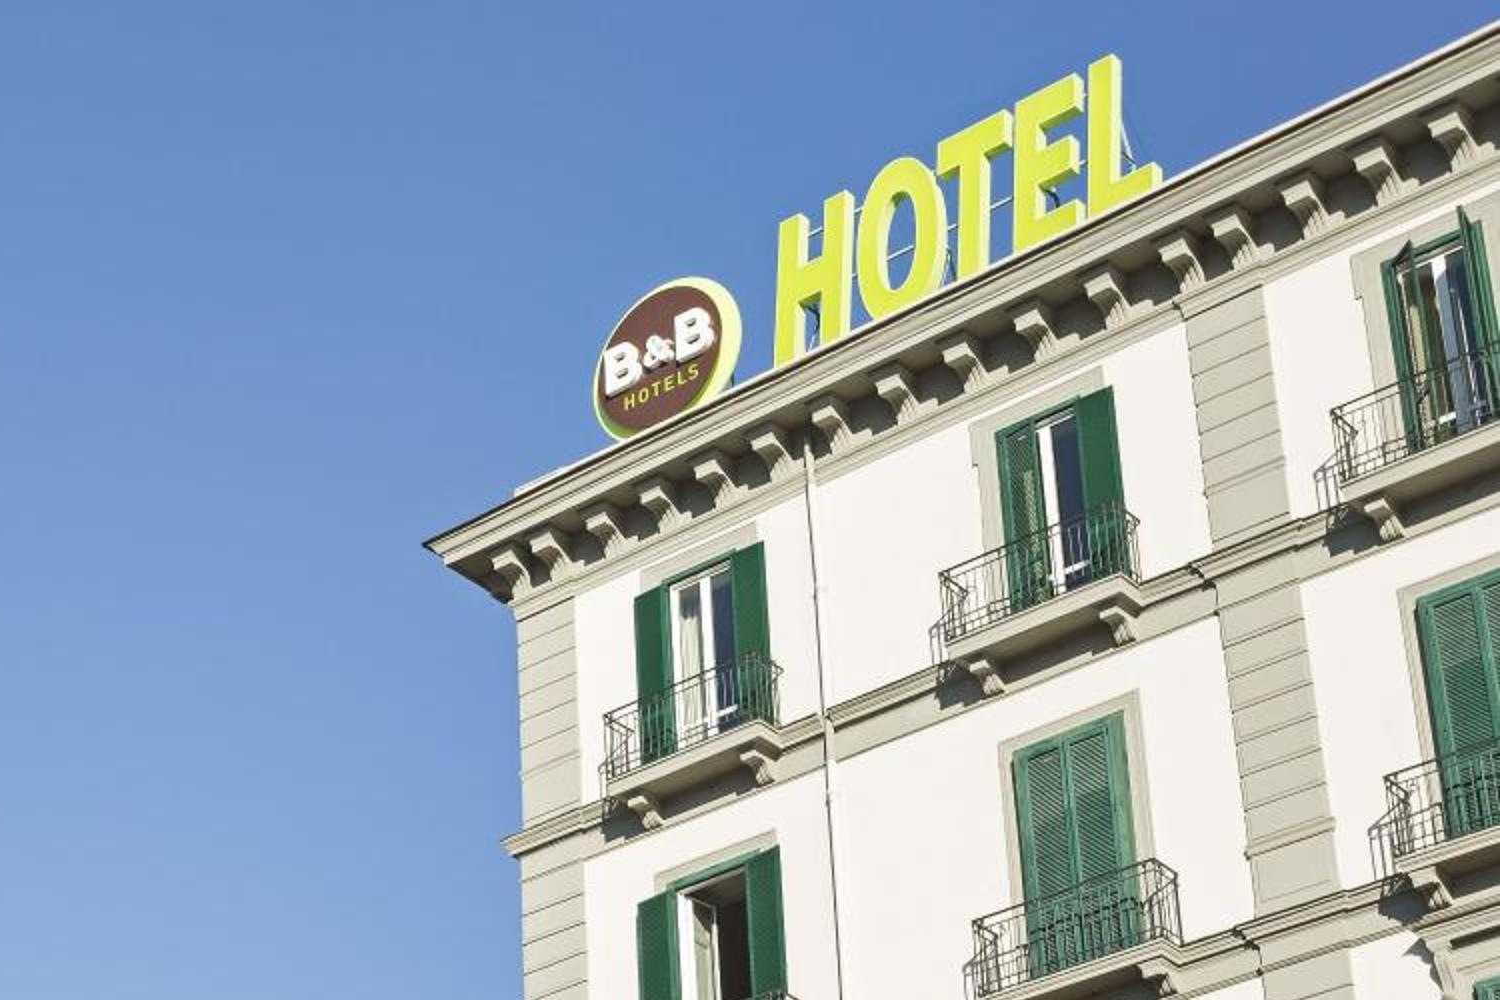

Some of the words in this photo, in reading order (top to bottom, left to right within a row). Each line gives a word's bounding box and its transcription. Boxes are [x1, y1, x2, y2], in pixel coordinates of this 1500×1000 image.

[775, 54, 1162, 367] HOTEL
[603, 307, 715, 398] B&B
[623, 363, 700, 411] HOTELS
